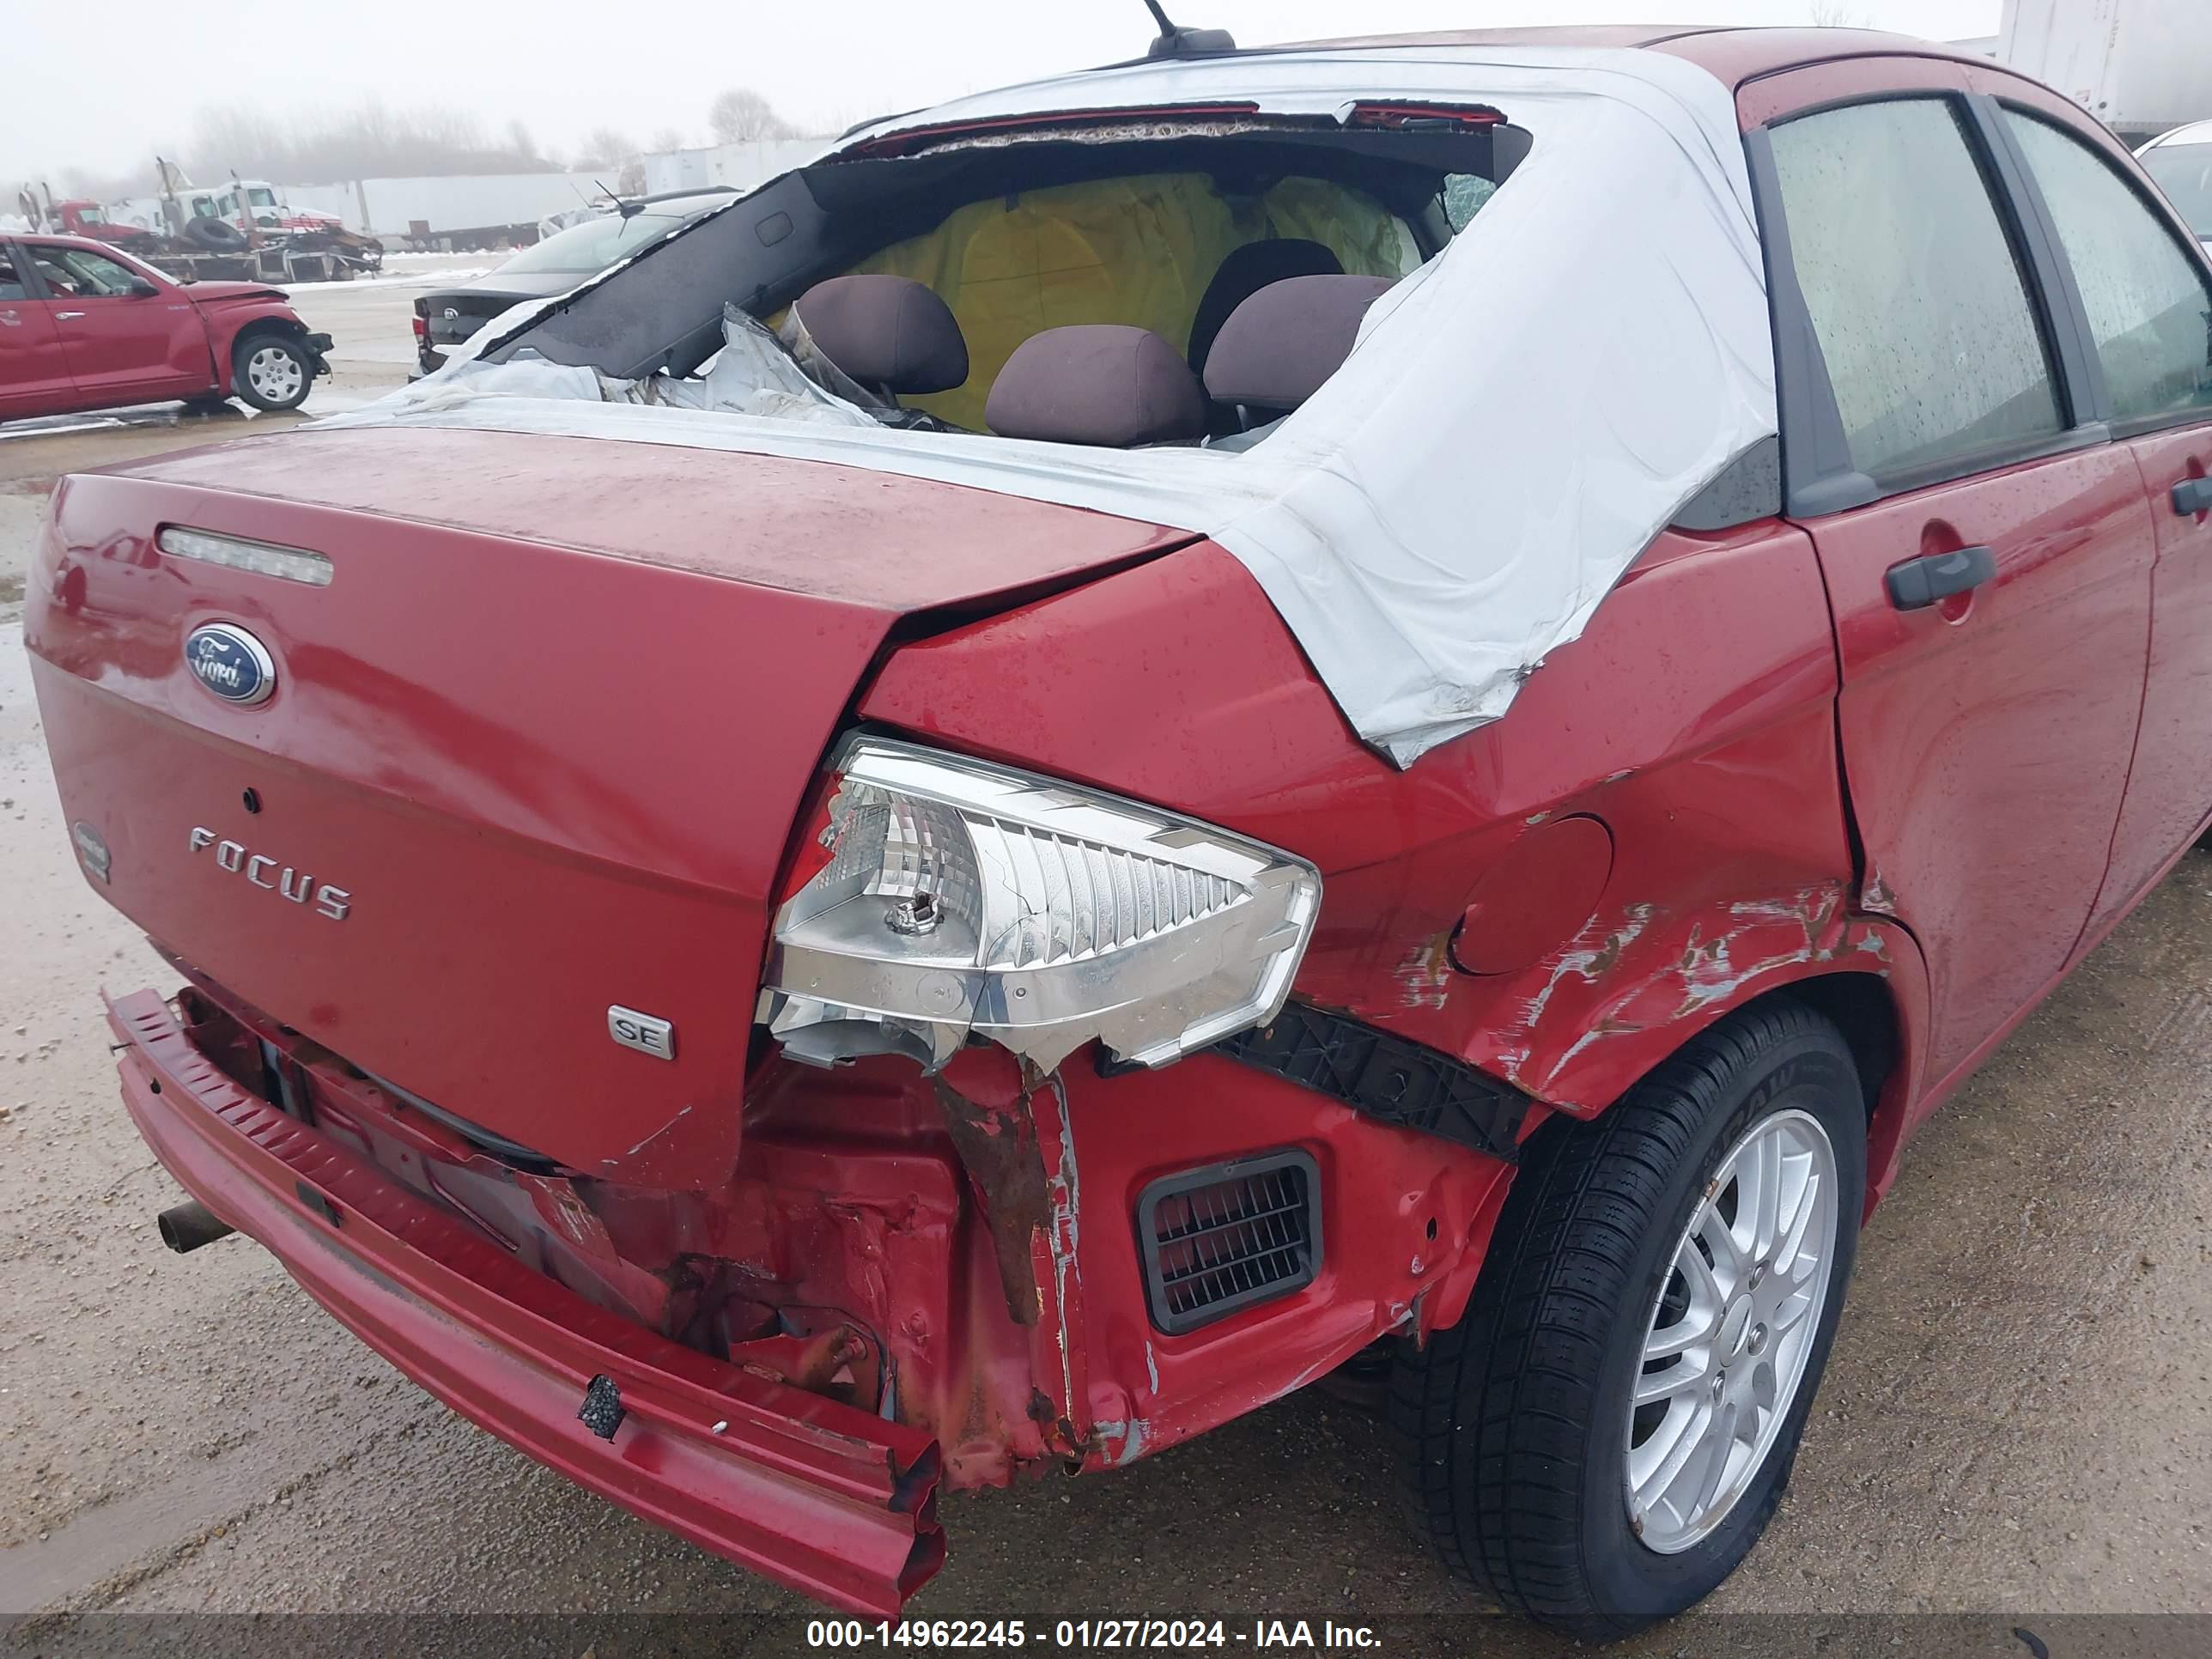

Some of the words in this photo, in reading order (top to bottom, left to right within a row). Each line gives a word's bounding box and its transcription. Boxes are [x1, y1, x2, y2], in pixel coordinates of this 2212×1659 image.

[194, 635, 242, 689] Ford
[188, 826, 351, 921] FOCUS
[616, 1018, 662, 1050] SE
